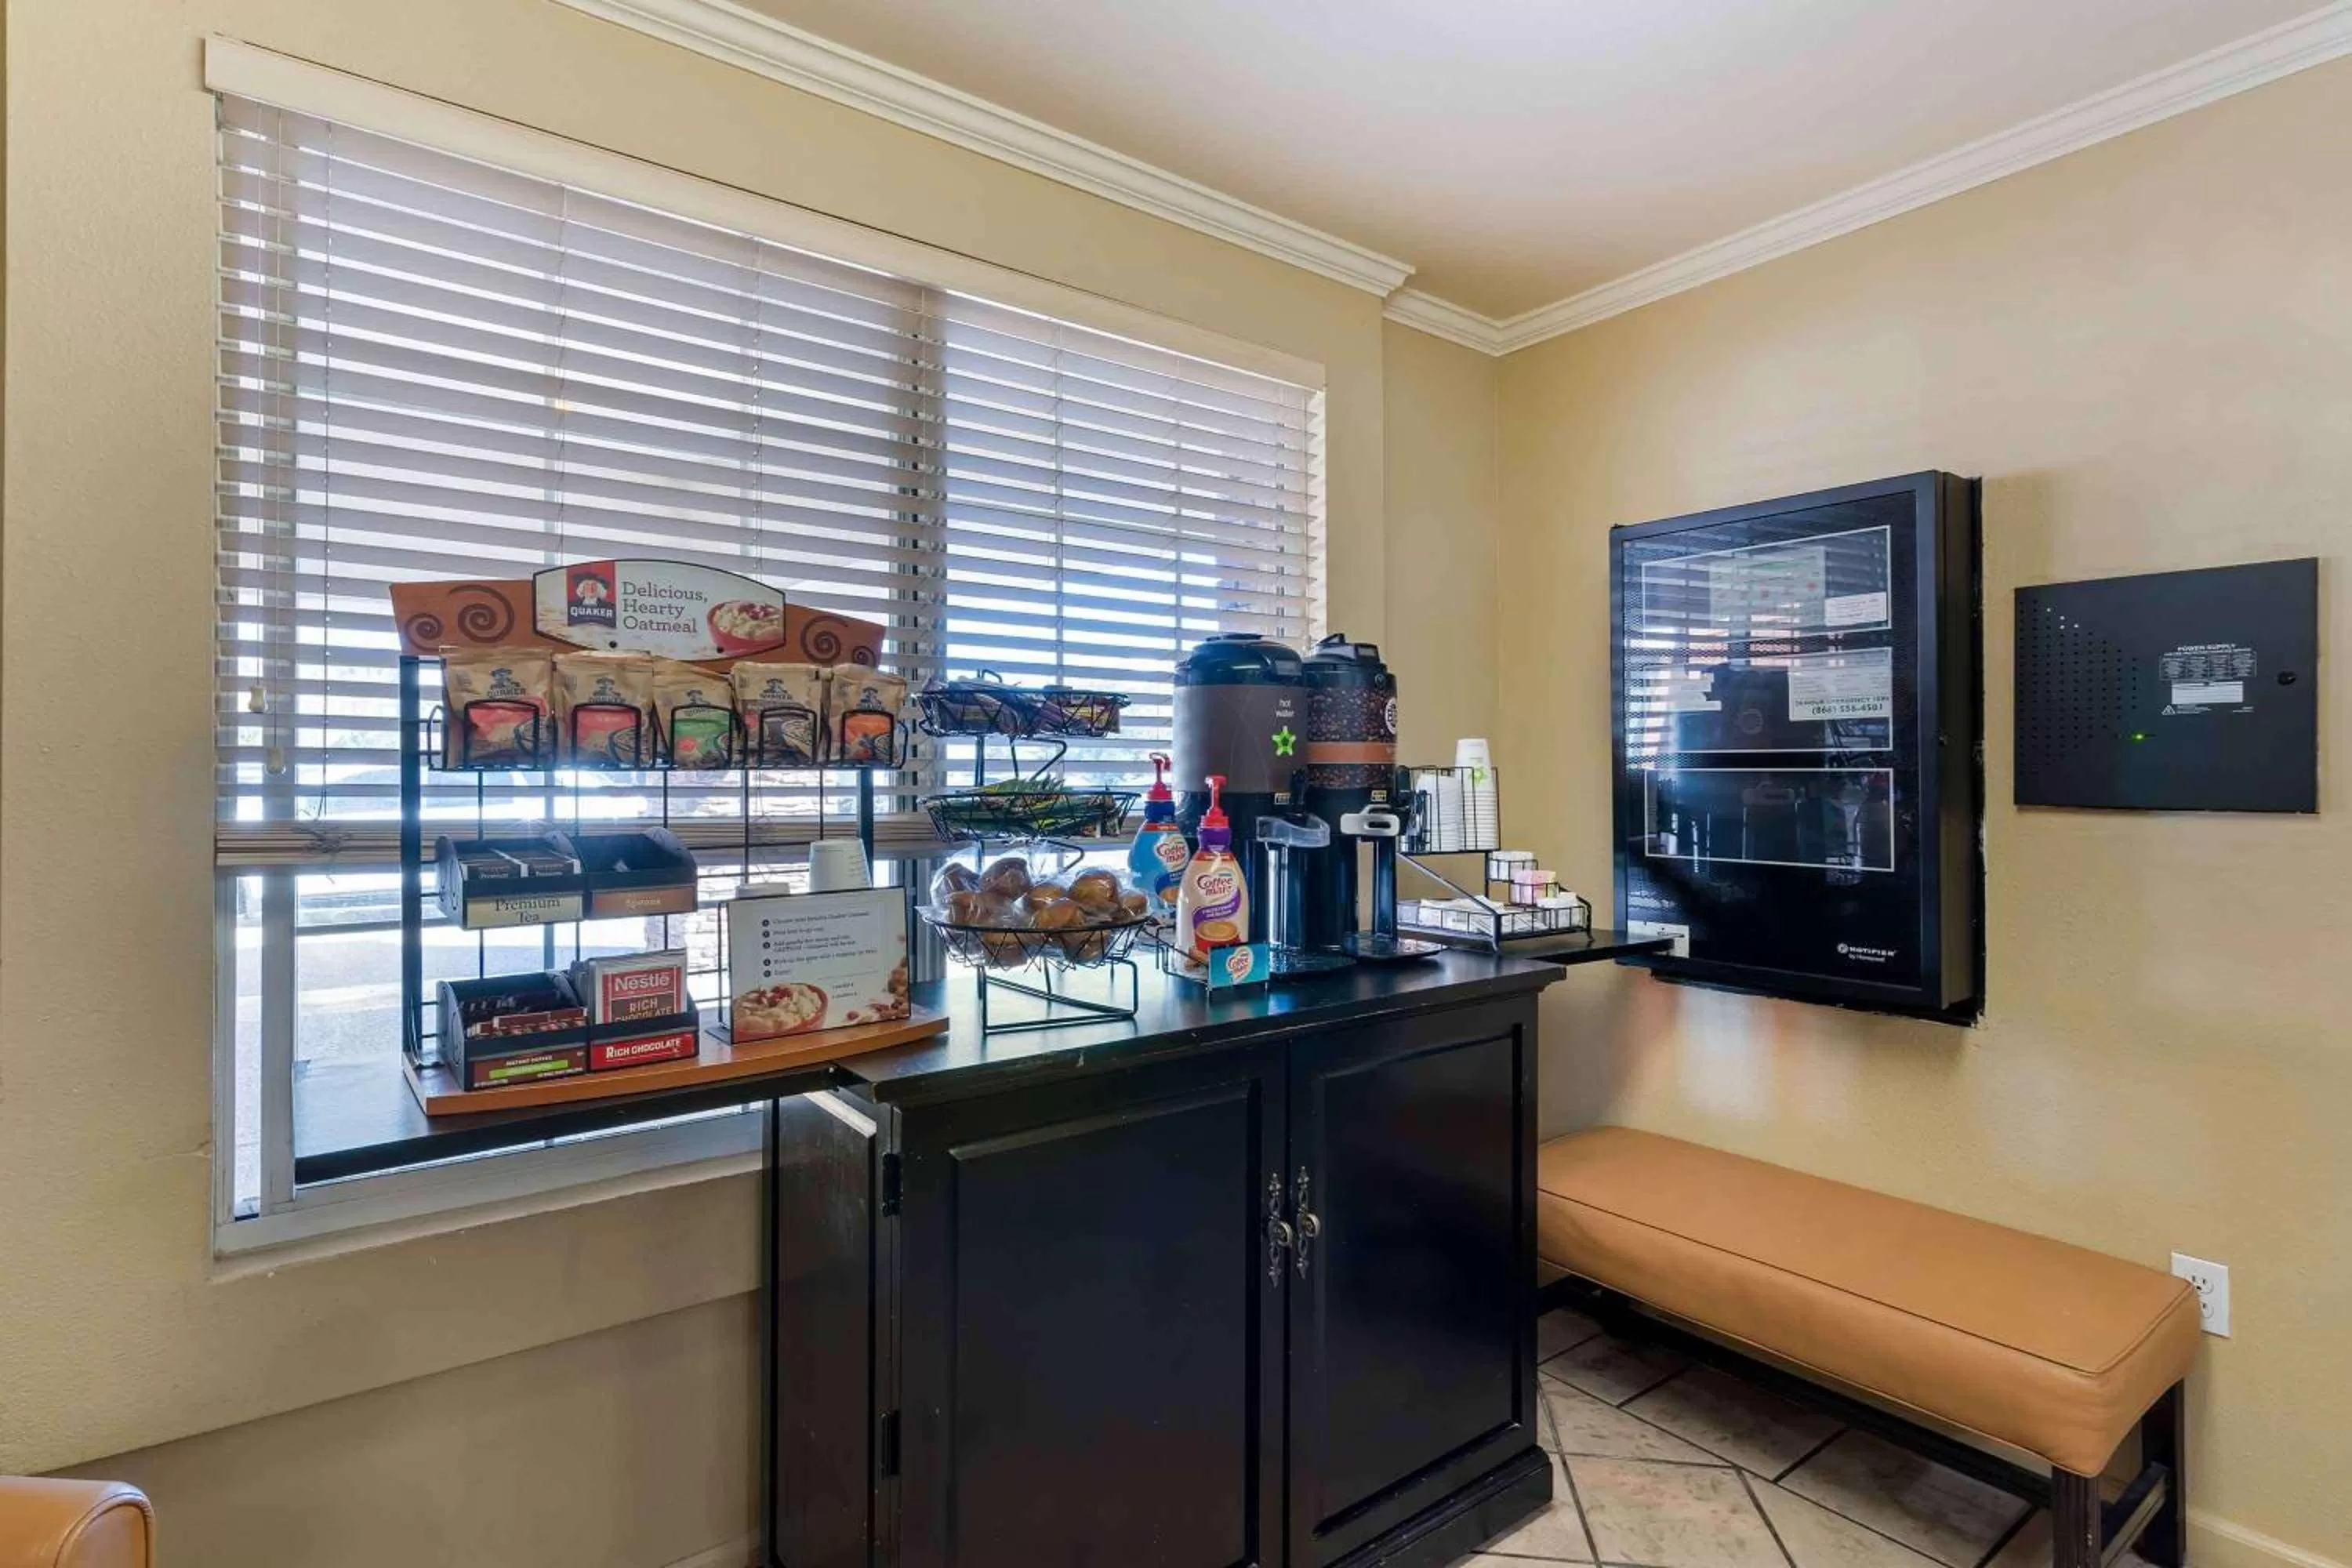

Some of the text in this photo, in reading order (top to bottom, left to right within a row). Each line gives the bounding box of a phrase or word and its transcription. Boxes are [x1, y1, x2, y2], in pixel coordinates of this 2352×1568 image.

[622, 581, 708, 602] Delicious,
[570, 606, 613, 619] QUAKER
[622, 598, 685, 619] Hearty
[622, 616, 698, 633] Oatmeal
[487, 687, 526, 699] QUAKER
[1279, 699, 1292, 708] hot
[1156, 842, 1186, 860] Coffee
[1196, 874, 1233, 891] Coffee
[495, 897, 561, 912] Premium
[518, 910, 540, 923] Tea
[630, 996, 658, 1013] RICH
[631, 1038, 681, 1054] CHOCOLATE
